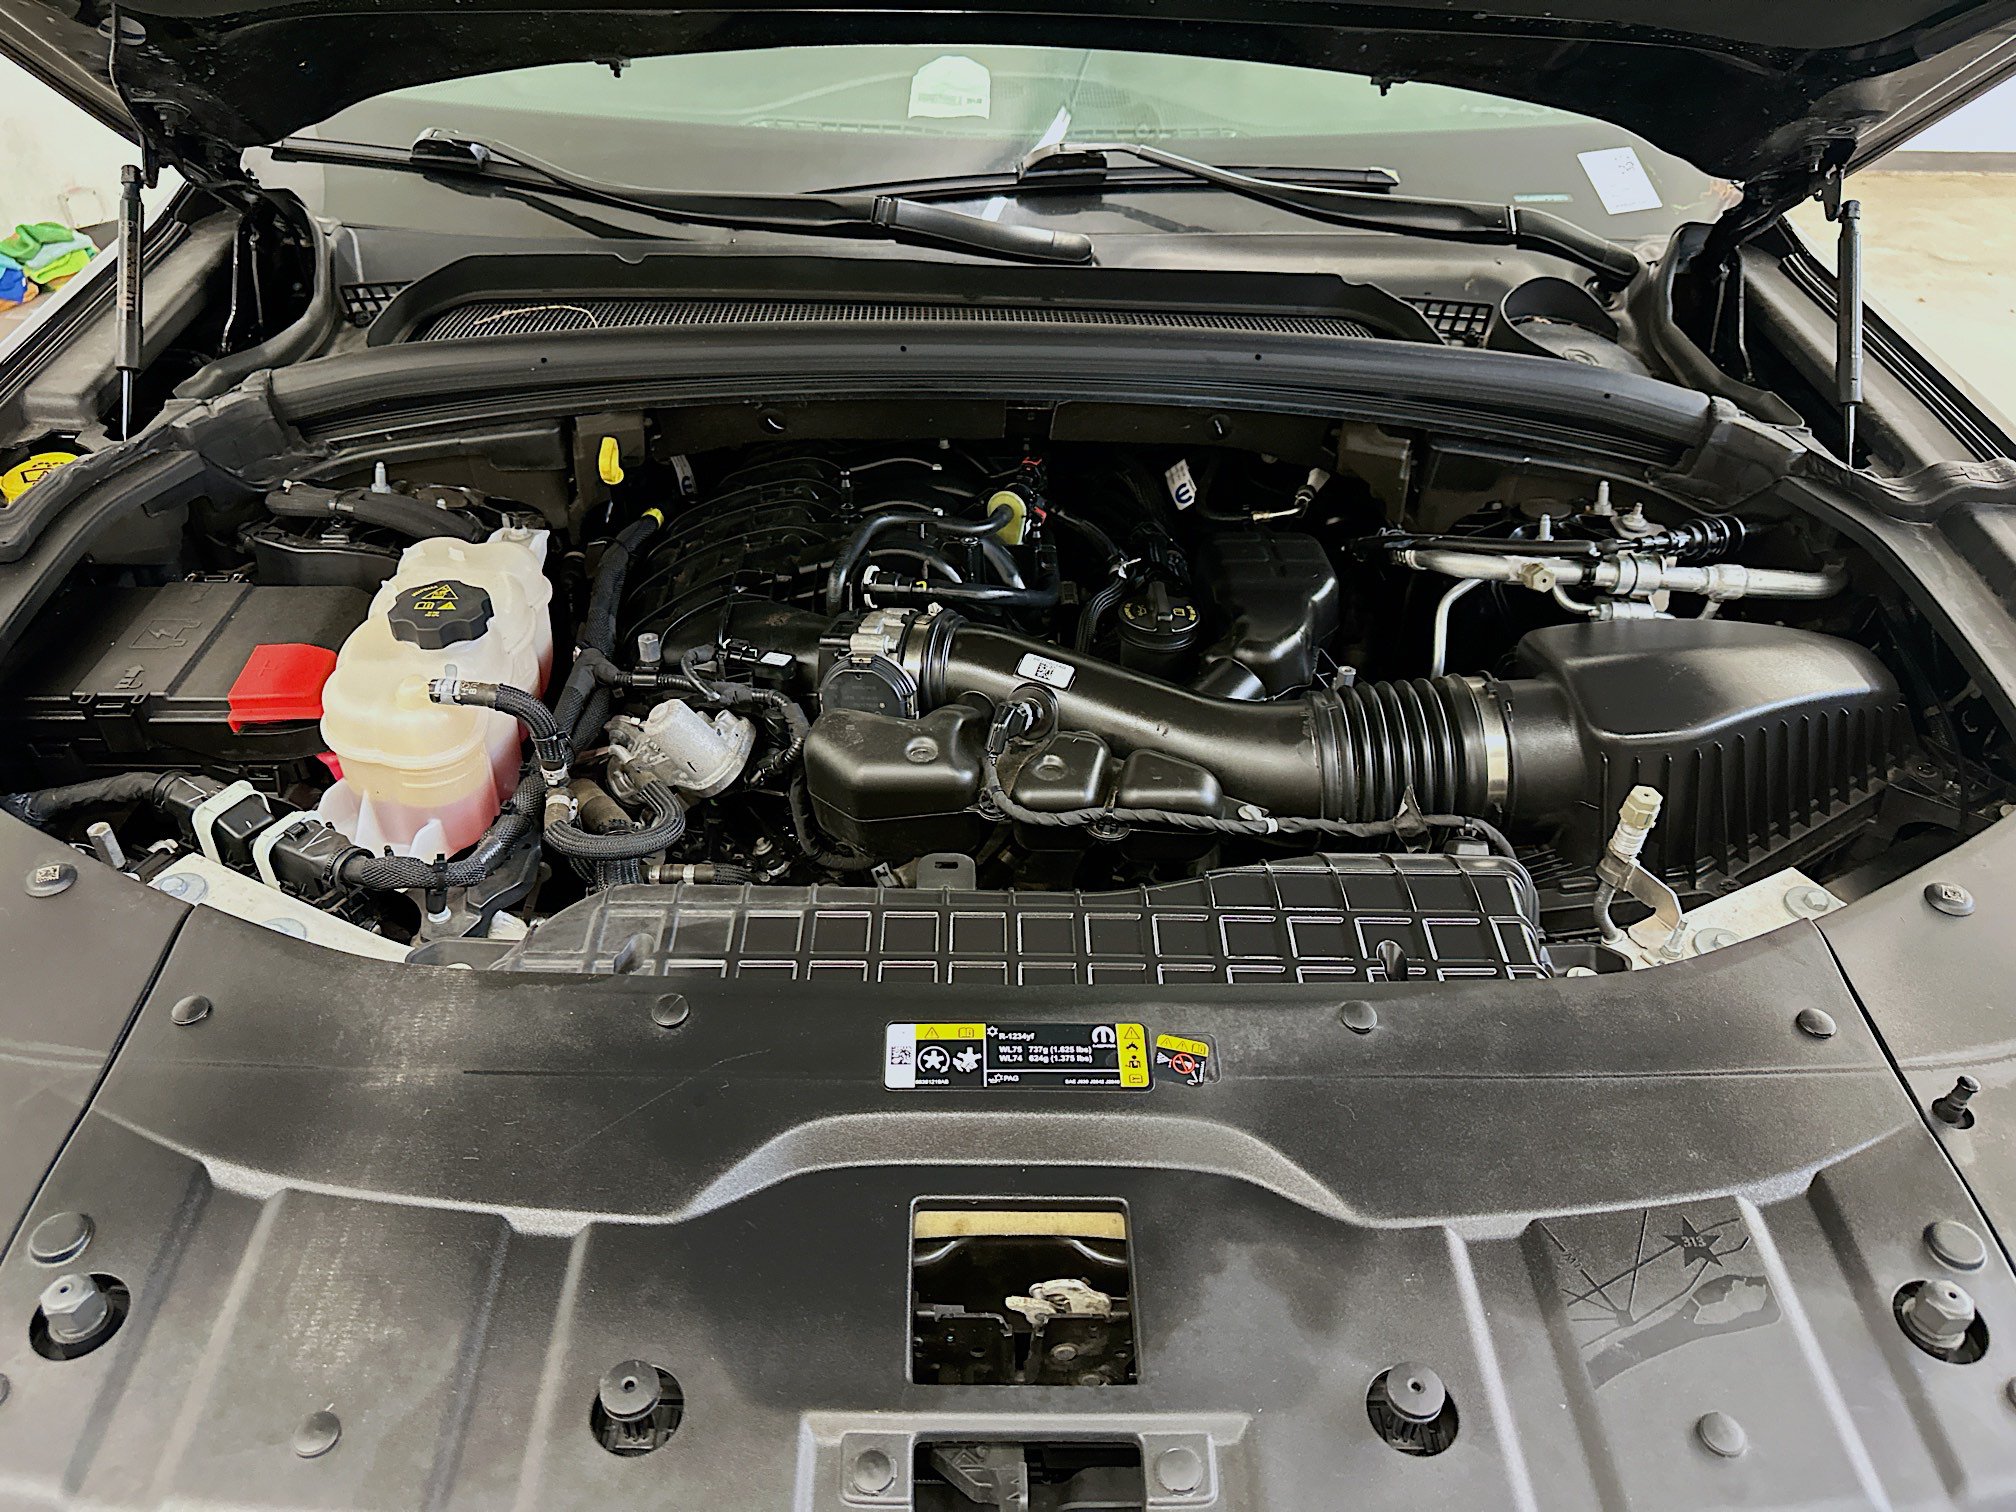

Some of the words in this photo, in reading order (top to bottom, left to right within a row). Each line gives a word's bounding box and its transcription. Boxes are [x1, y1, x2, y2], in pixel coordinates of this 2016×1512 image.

[999, 1033, 1035, 1041] R-1234yf
[1028, 1046, 1048, 1054] 737g
[1681, 1236, 1707, 1248] 313
